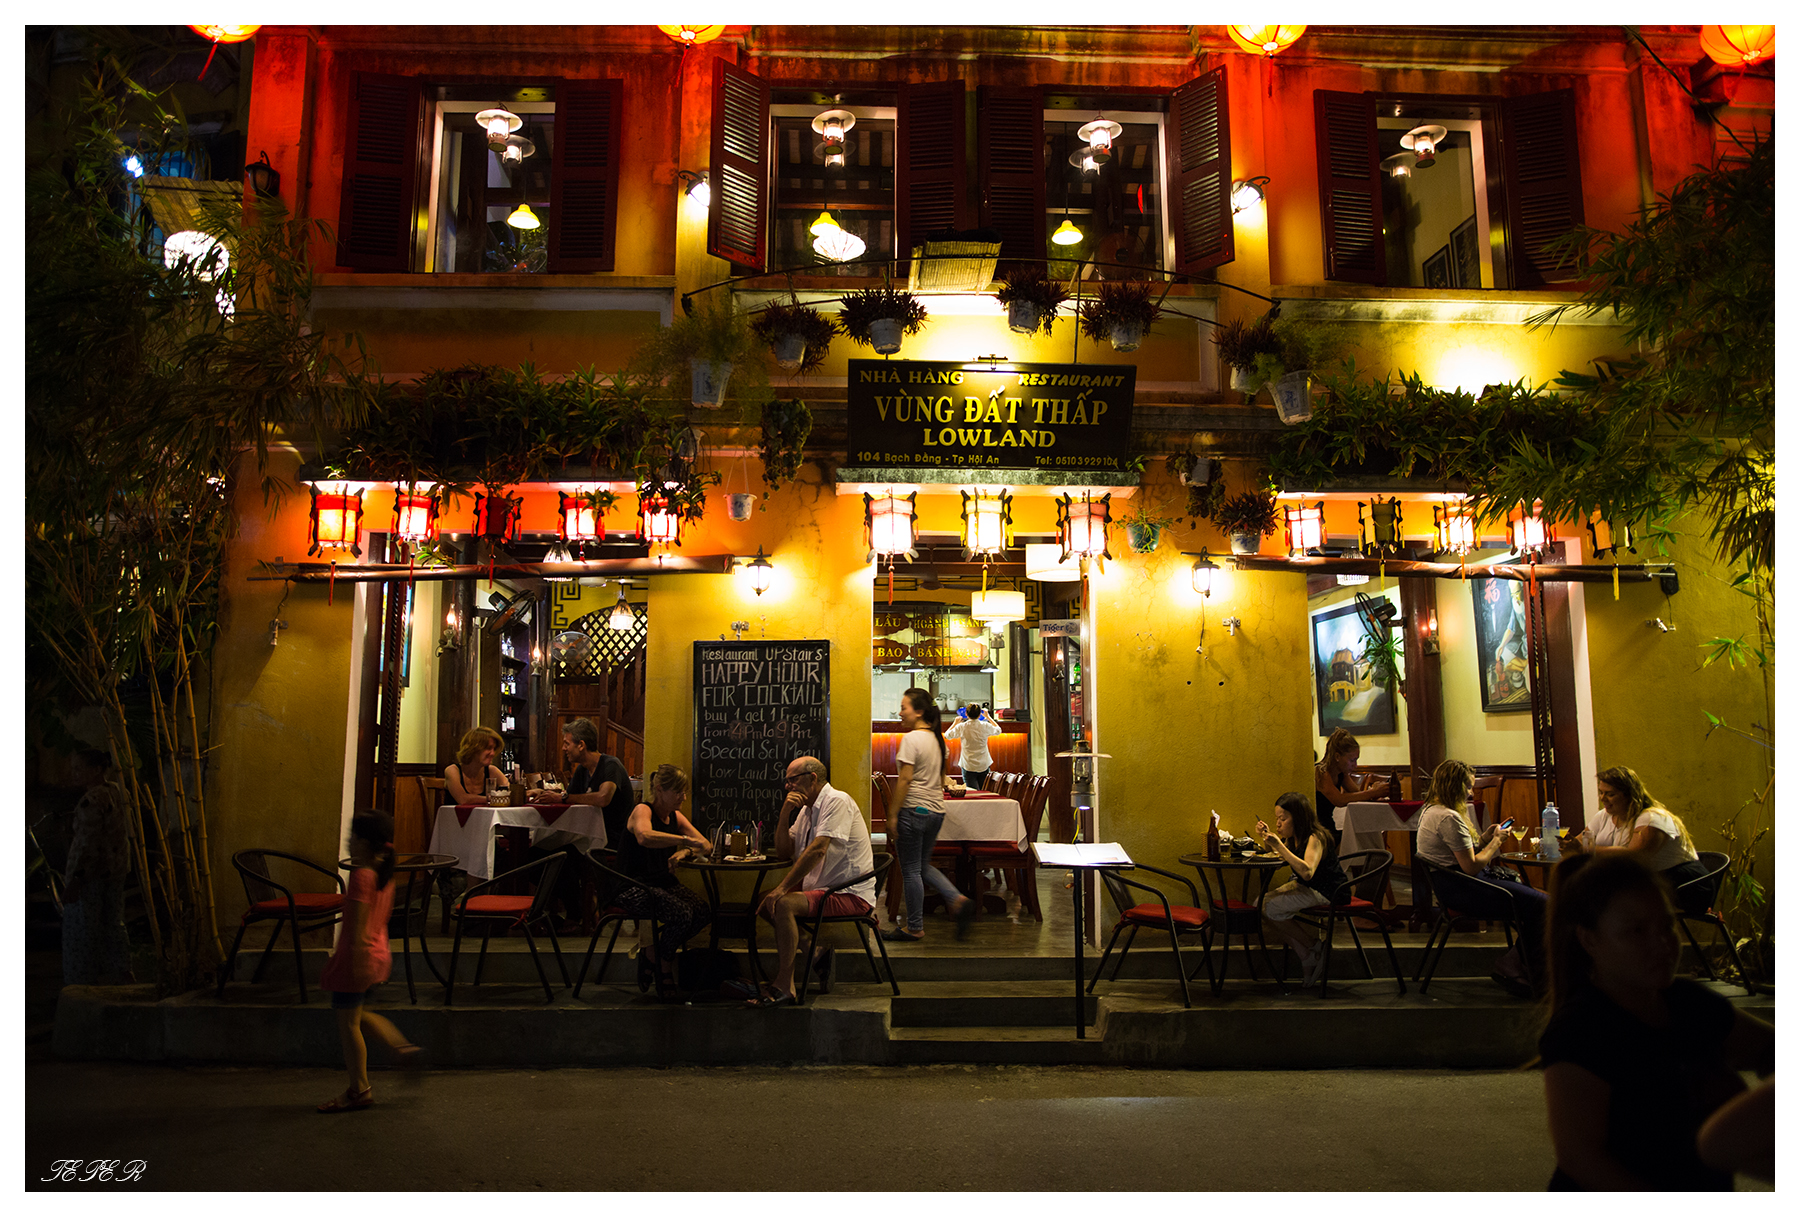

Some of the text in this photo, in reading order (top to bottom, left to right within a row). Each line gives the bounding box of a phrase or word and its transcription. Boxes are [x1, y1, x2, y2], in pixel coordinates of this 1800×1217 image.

[859, 367, 1125, 388] NHÀ HÀNG RESTAURANT
[874, 385, 1109, 426] VÙNG ĐẤT THẤP
[923, 427, 1056, 448] LOWLAND
[857, 452, 881, 462] 104
[884, 453, 910, 464] Bạch
[952, 454, 965, 465] Tp
[968, 454, 983, 465] Hội
[986, 455, 1000, 464] An
[1035, 456, 1053, 465] Tel:
[1043, 623, 1065, 634] Tiger
[702, 647, 758, 660] Restaurant
[877, 647, 903, 657] BAO
[917, 645, 953, 658] BÁNH
[702, 661, 820, 686] HAPPY HOUR
[703, 685, 736, 707] FOR
[704, 709, 727, 725] buy
[734, 707, 740, 721] 1
[745, 707, 765, 724] get
[770, 707, 776, 721] 1
[700, 739, 755, 760] Special
[706, 780, 783, 808] Green Papaya
[705, 802, 752, 820] Chicken
